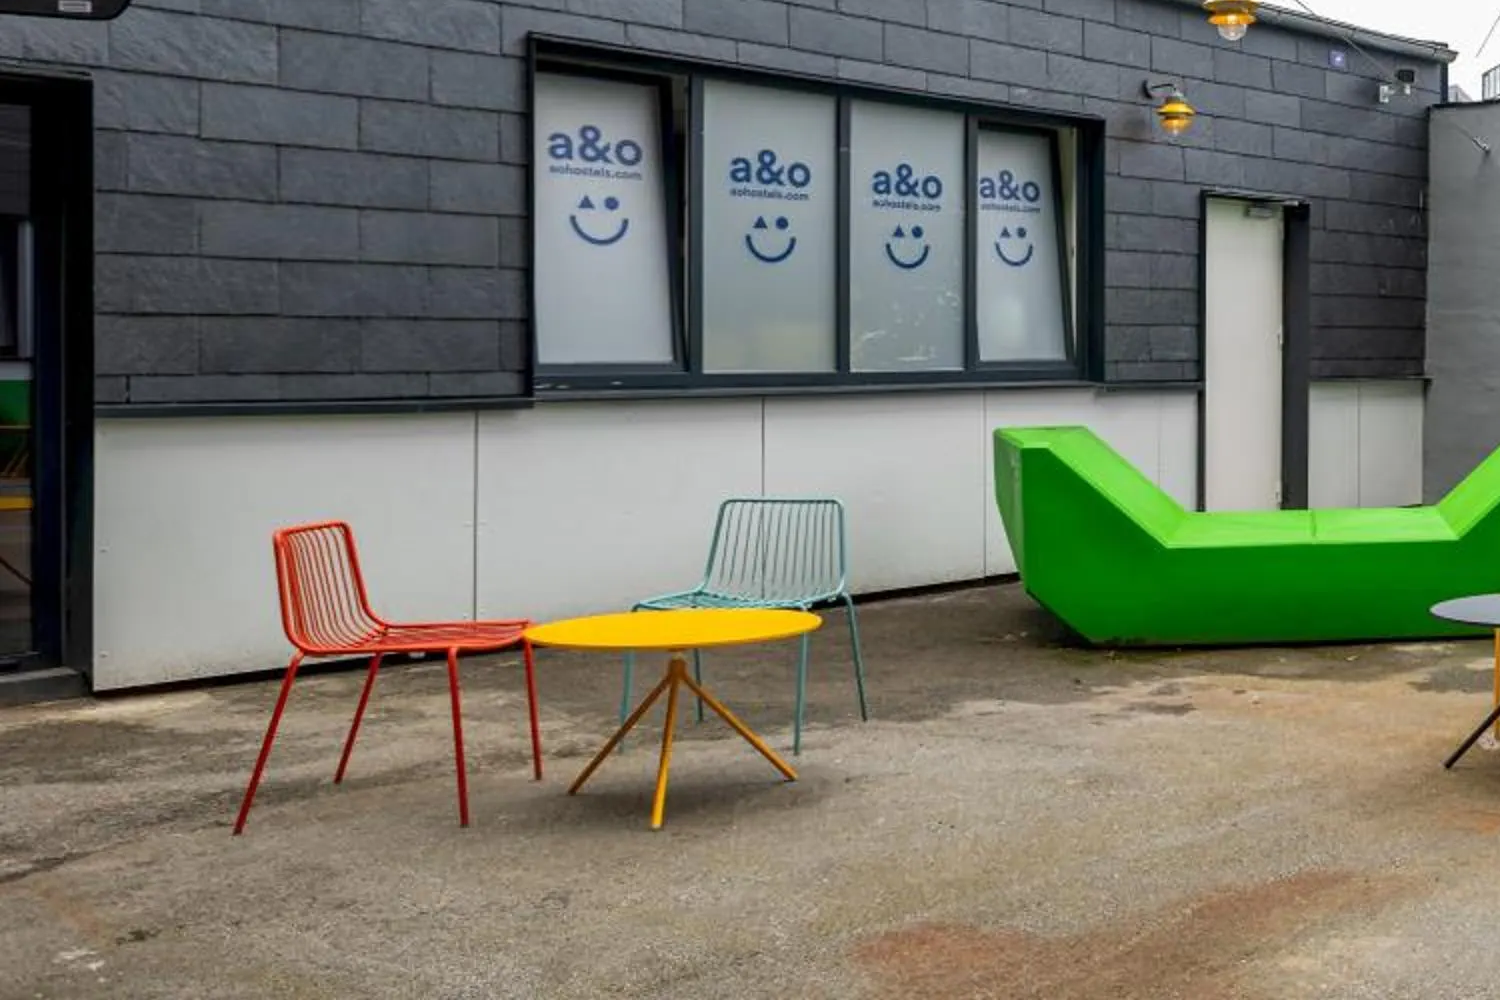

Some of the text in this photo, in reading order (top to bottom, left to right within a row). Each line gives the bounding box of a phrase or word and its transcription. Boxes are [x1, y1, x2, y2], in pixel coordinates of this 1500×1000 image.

[547, 125, 643, 166] a&o
[729, 149, 811, 188] a&o
[872, 163, 942, 199] a&o
[979, 169, 1041, 202] a&o
